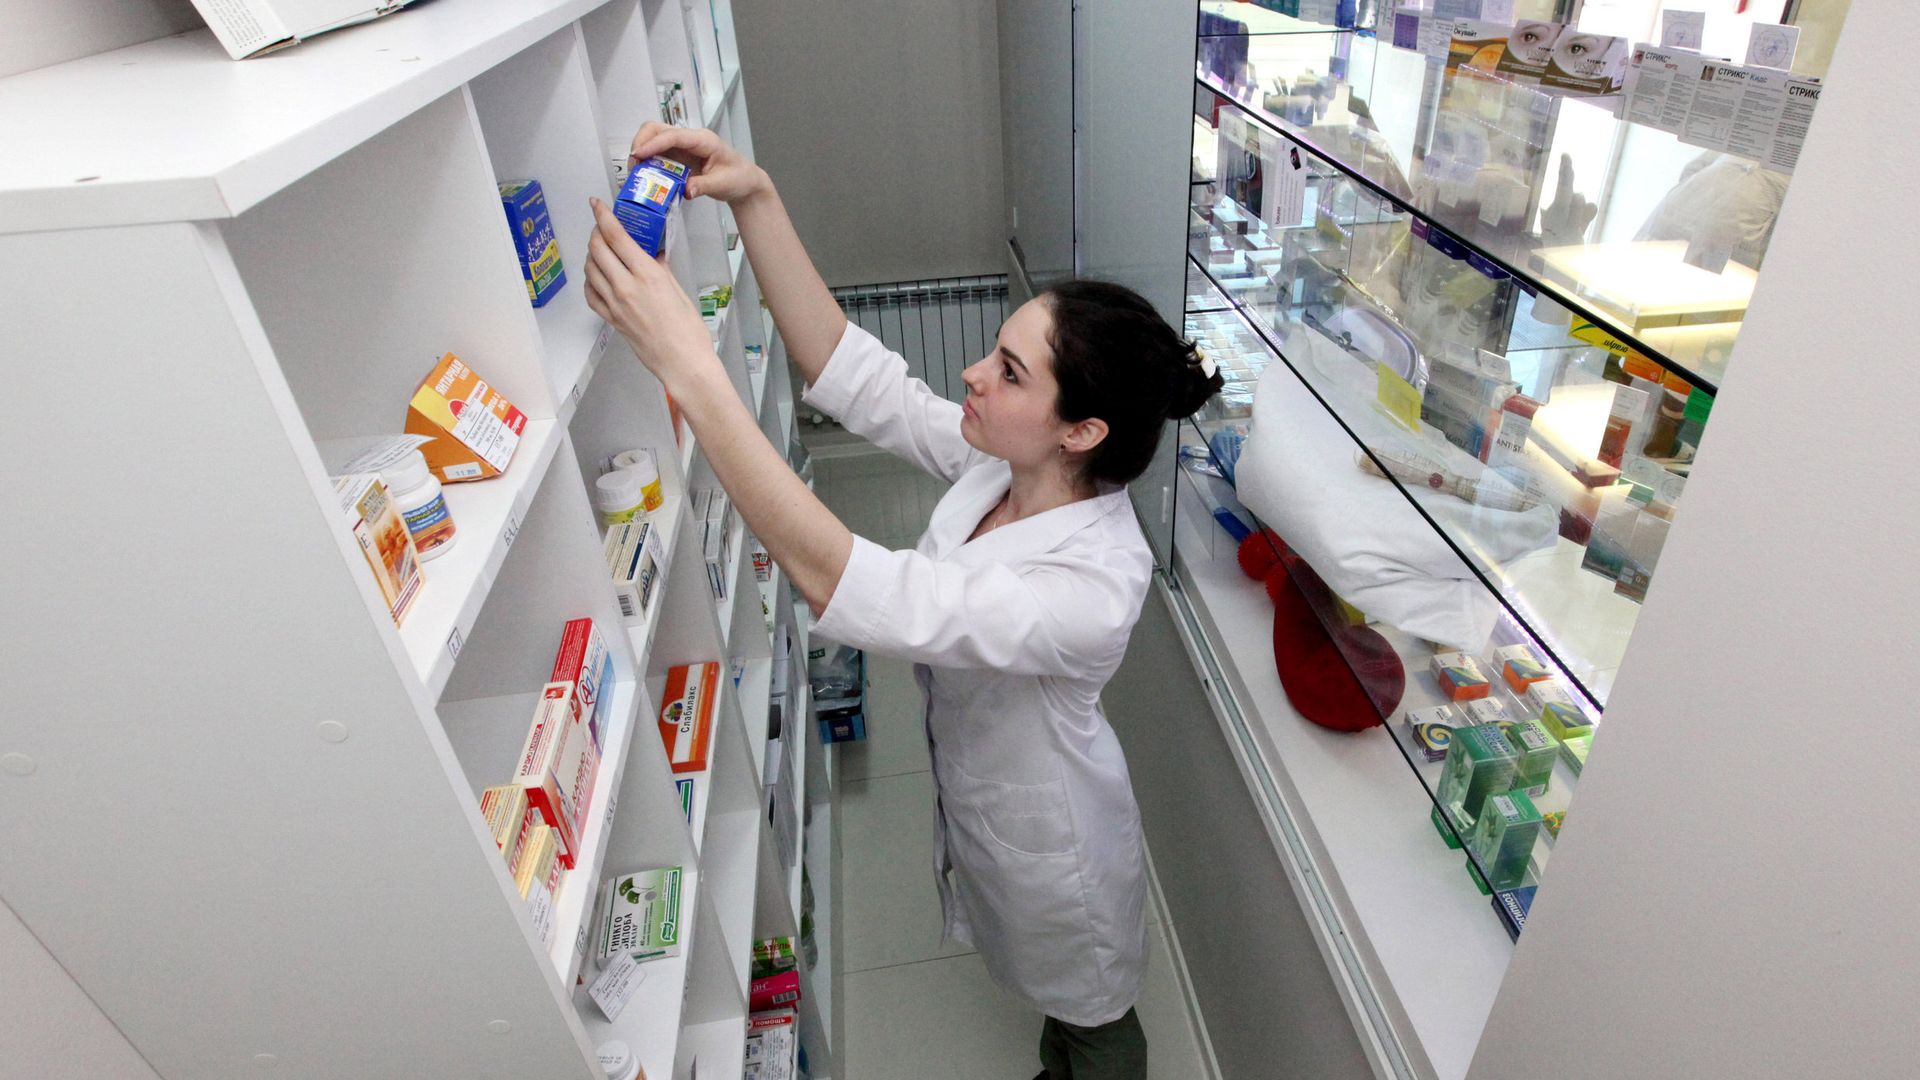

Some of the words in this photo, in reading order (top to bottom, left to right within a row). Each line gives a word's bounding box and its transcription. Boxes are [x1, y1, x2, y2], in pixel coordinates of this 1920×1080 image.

[1718, 68, 1746, 79] СТРИКС
[434, 358, 465, 395] ЯНТАРНАЯ
[680, 685, 697, 733] Слабилакс
[1502, 892, 1527, 929] ОГИПНОЗ
[610, 916, 622, 952] ГИНКГО
